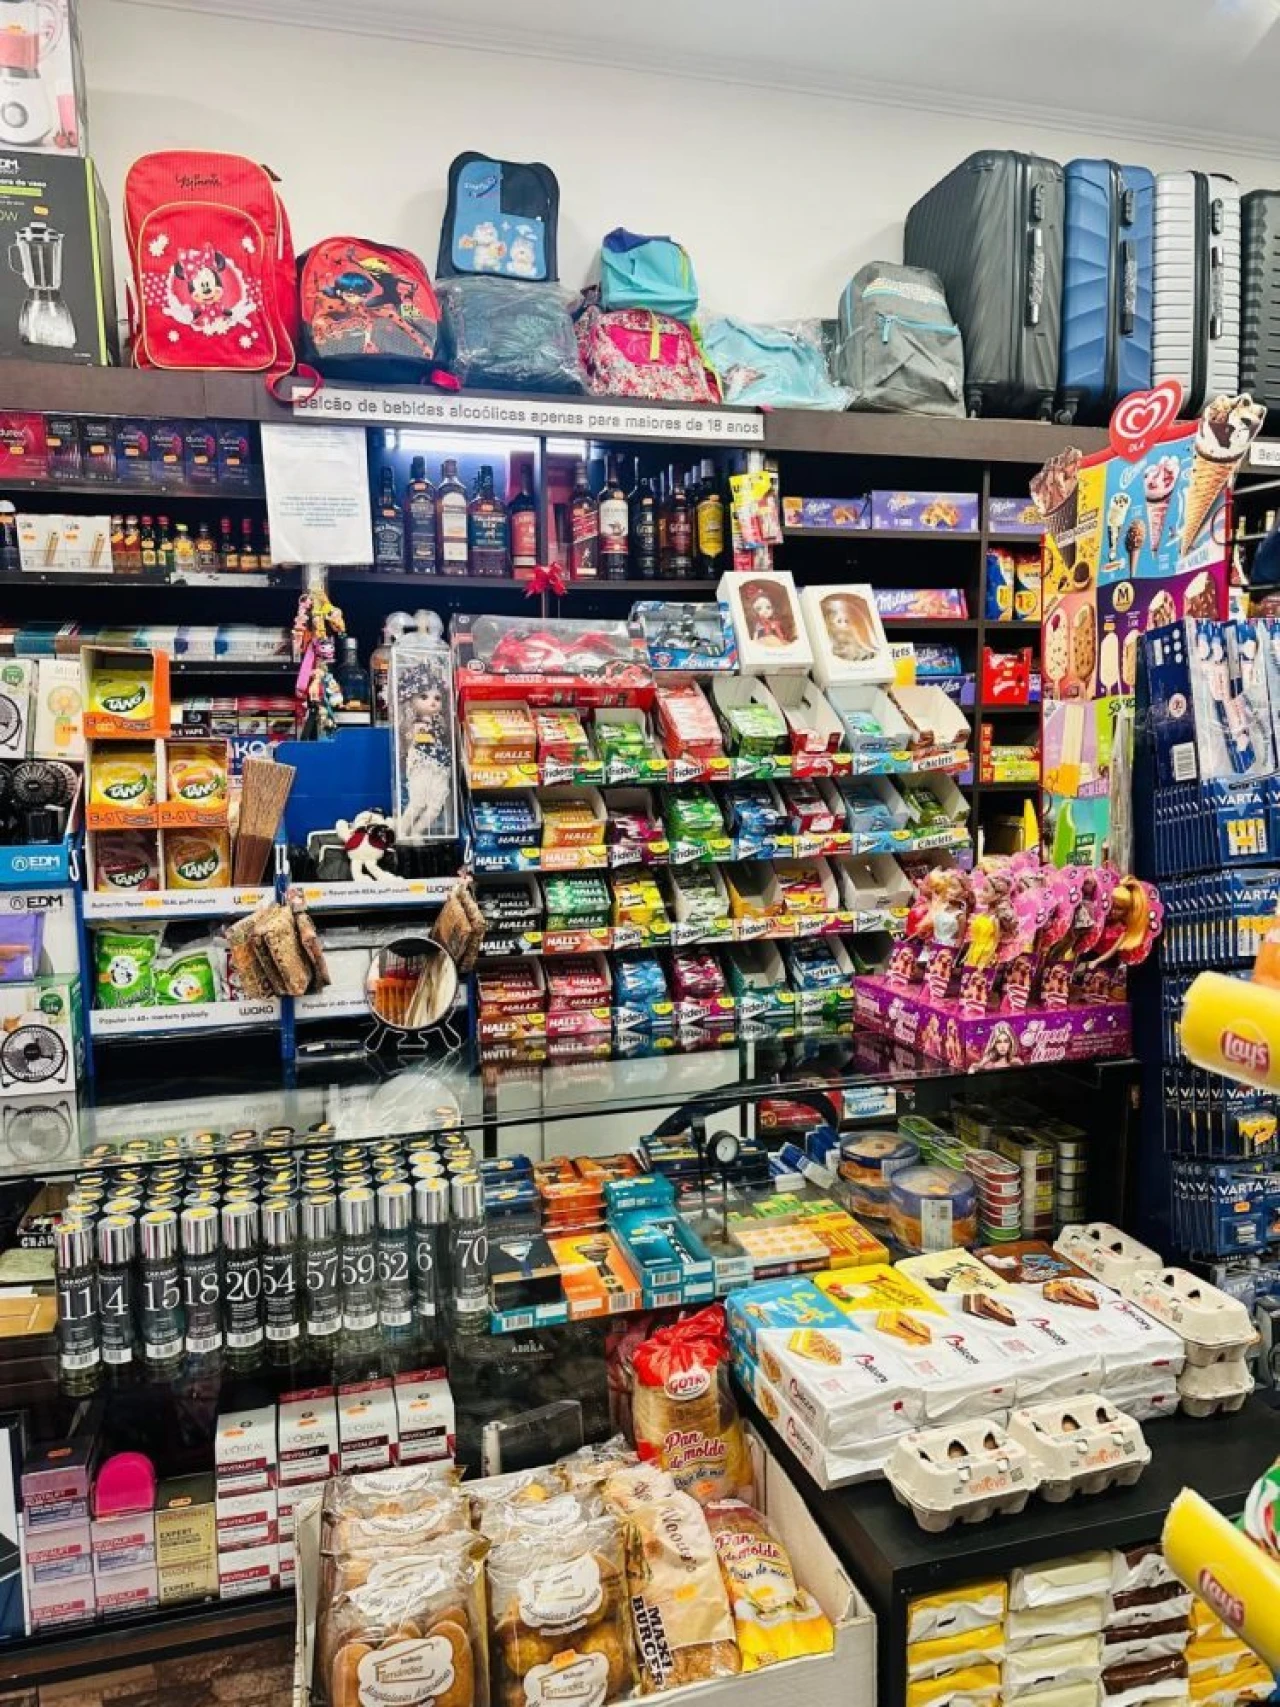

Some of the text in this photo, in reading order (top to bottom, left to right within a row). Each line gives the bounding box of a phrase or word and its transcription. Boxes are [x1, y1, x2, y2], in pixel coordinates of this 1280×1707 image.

[299, 396, 759, 434] Balcão de bebidas alcoólicas apenas para maiores de 18 anos
[494, 750, 531, 760] HALLS
[543, 767, 573, 779] Trident
[608, 767, 638, 778] Trident
[673, 766, 705, 778] Trident
[111, 782, 144, 798] TANG
[186, 783, 218, 798] TANG
[1218, 793, 1262, 805] VARTA
[498, 835, 534, 844] HALLS
[545, 853, 578, 863] HALLS
[612, 850, 641, 862] Trident
[674, 847, 706, 859] Trident
[30, 856, 60, 867] EDM
[476, 856, 511, 866] HALLS
[180, 861, 216, 878] TANG
[113, 869, 147, 886] TANG
[1234, 888, 1278, 901] VARTA
[27, 895, 63, 909] EDM
[499, 920, 535, 929] HALLS
[568, 915, 602, 924] HALLS
[675, 927, 706, 939] Trident
[737, 922, 771, 935] Trident
[547, 936, 581, 946] HALLS
[614, 931, 641, 943] Trident
[480, 940, 516, 951] HALLS
[571, 996, 605, 1005] HALLS
[503, 1002, 539, 1012] HALLS
[678, 1006, 710, 1019] Trident
[740, 1001, 770, 1014] Trident
[549, 1017, 583, 1027] HALLS
[615, 1013, 647, 1025] Trident
[483, 1022, 517, 1034] HALLS
[1219, 1182, 1265, 1196] VARTA
[457, 1236, 488, 1268] 70
[342, 1253, 375, 1285] 59
[378, 1251, 409, 1281] 62
[263, 1264, 296, 1295] 54
[306, 1257, 338, 1290] 57
[184, 1273, 219, 1306] 18
[226, 1268, 260, 1301] 20
[144, 1277, 180, 1312] 15
[61, 1287, 96, 1320] 11
[665, 1430, 699, 1454] Pan
[670, 1439, 726, 1469] de molde
[218, 1461, 257, 1473] REVITALIFT
[160, 1528, 192, 1539] EXPERT
[221, 1569, 260, 1582] REVITALIFT
[163, 1581, 195, 1593] EXPERT
[632, 1596, 664, 1686] BURGER
[648, 1606, 672, 1667] MAXI
